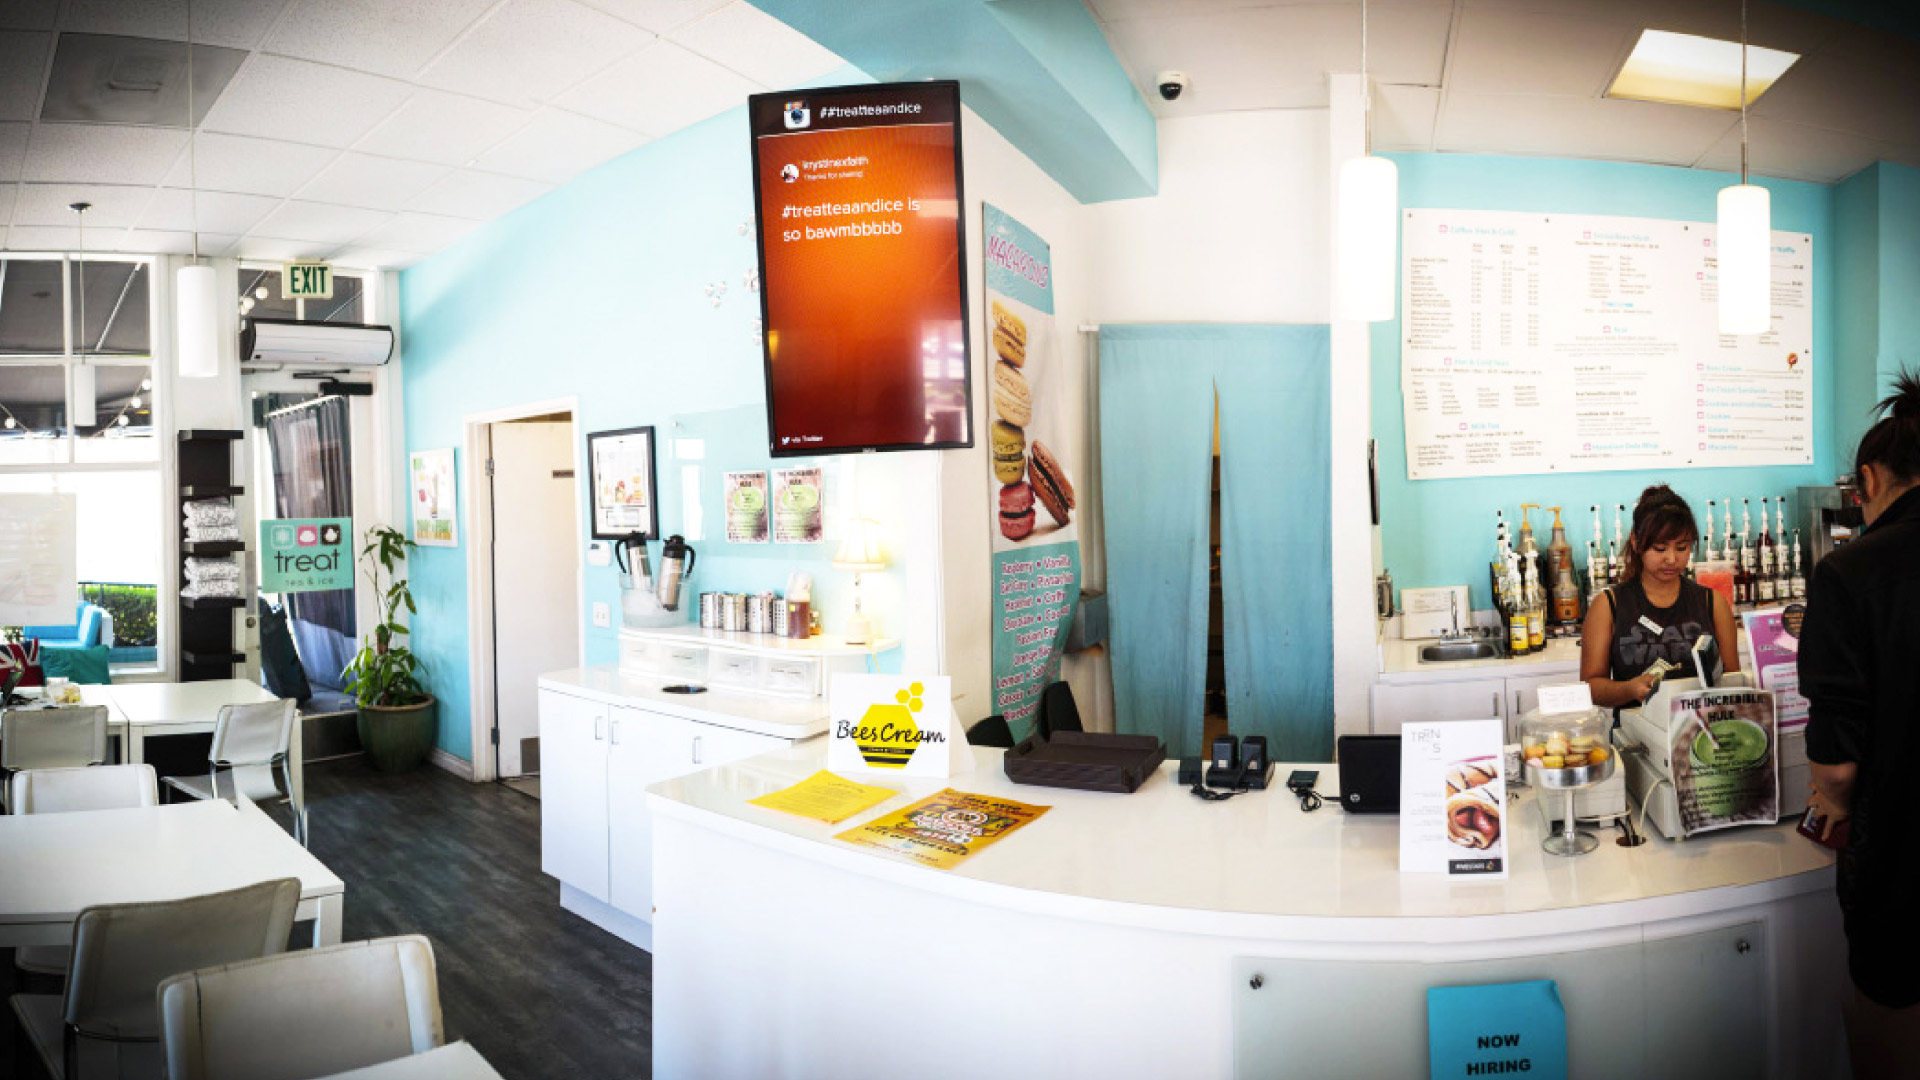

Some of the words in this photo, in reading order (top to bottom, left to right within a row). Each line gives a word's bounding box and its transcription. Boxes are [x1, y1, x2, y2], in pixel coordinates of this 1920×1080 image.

[820, 102, 922, 119] ##treatteaandice
[782, 198, 903, 218] #treatteaandice
[908, 196, 921, 211] is
[783, 228, 801, 242] so
[986, 234, 1049, 289] MACARONS
[290, 266, 328, 295] EXIT
[274, 548, 340, 574] treat
[285, 578, 304, 587] tea
[317, 576, 334, 585] ice
[1680, 698, 1701, 710] THE
[1704, 693, 1765, 707] INCREDIBLE
[1477, 1033, 1520, 1050] NOW
[1466, 1058, 1531, 1076] HIRING
